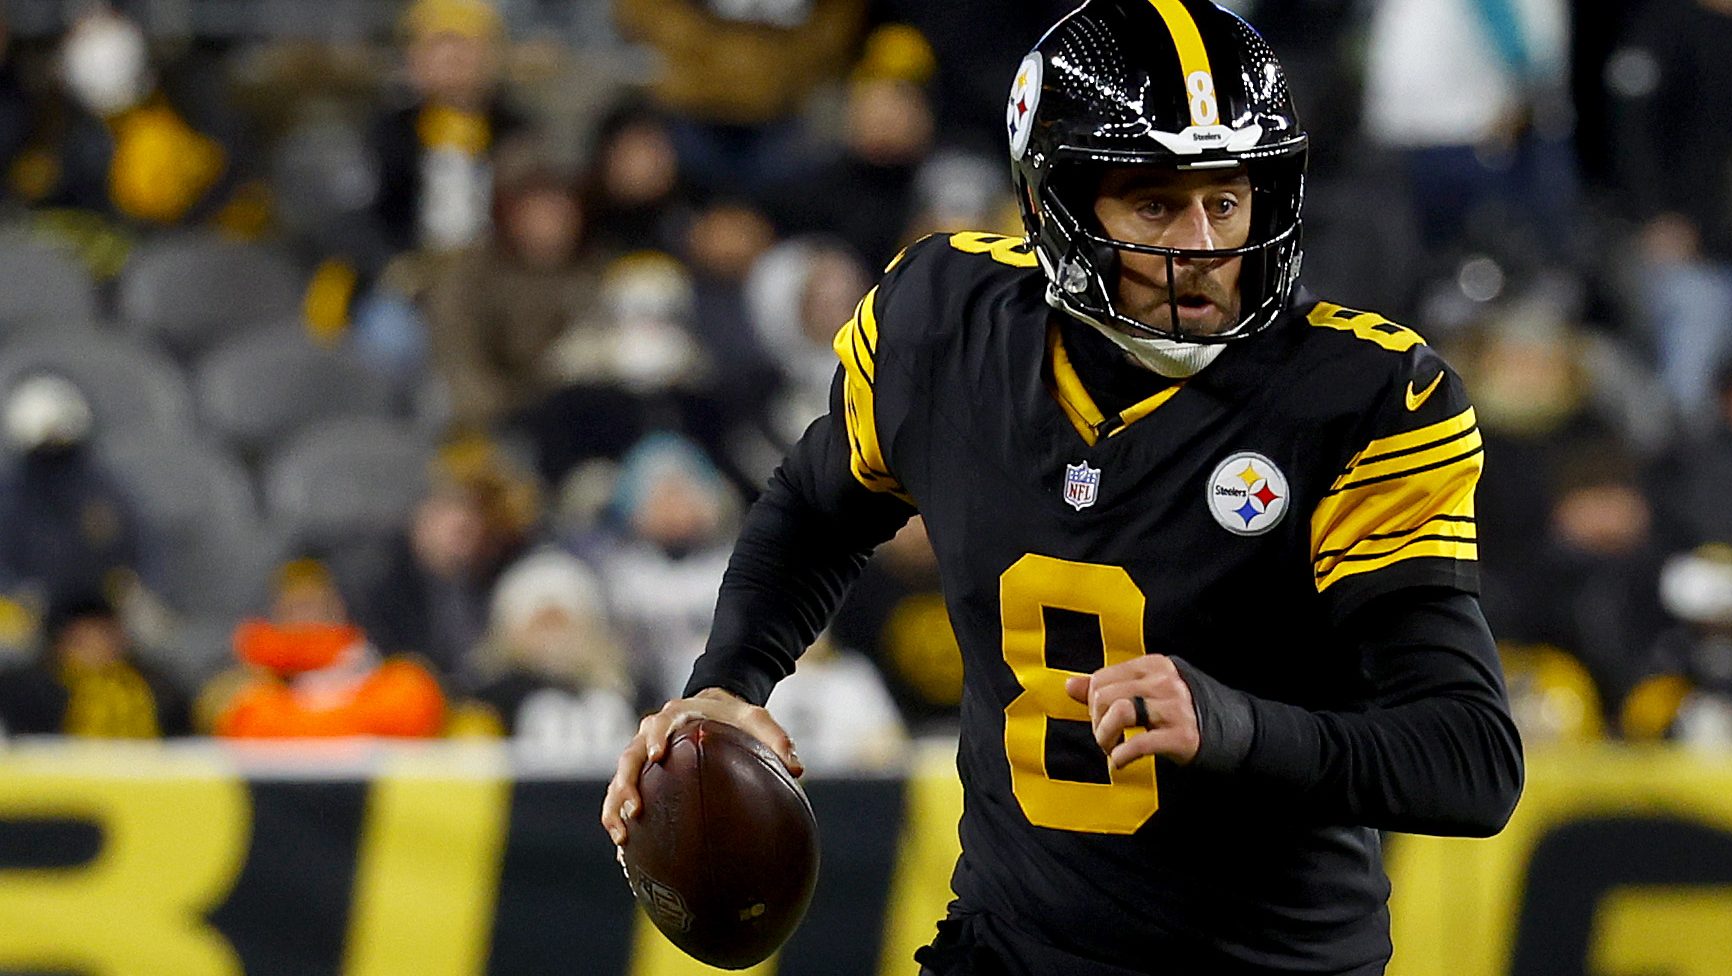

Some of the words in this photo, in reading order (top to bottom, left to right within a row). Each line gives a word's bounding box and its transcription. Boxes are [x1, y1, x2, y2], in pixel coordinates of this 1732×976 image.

[1186, 70, 1218, 125] 8
[1193, 133, 1221, 141] Steelers
[1306, 301, 1427, 352] 8
[1069, 483, 1091, 500] NFL
[1215, 484, 1246, 497] Steelers
[1000, 553, 1159, 835] 8
